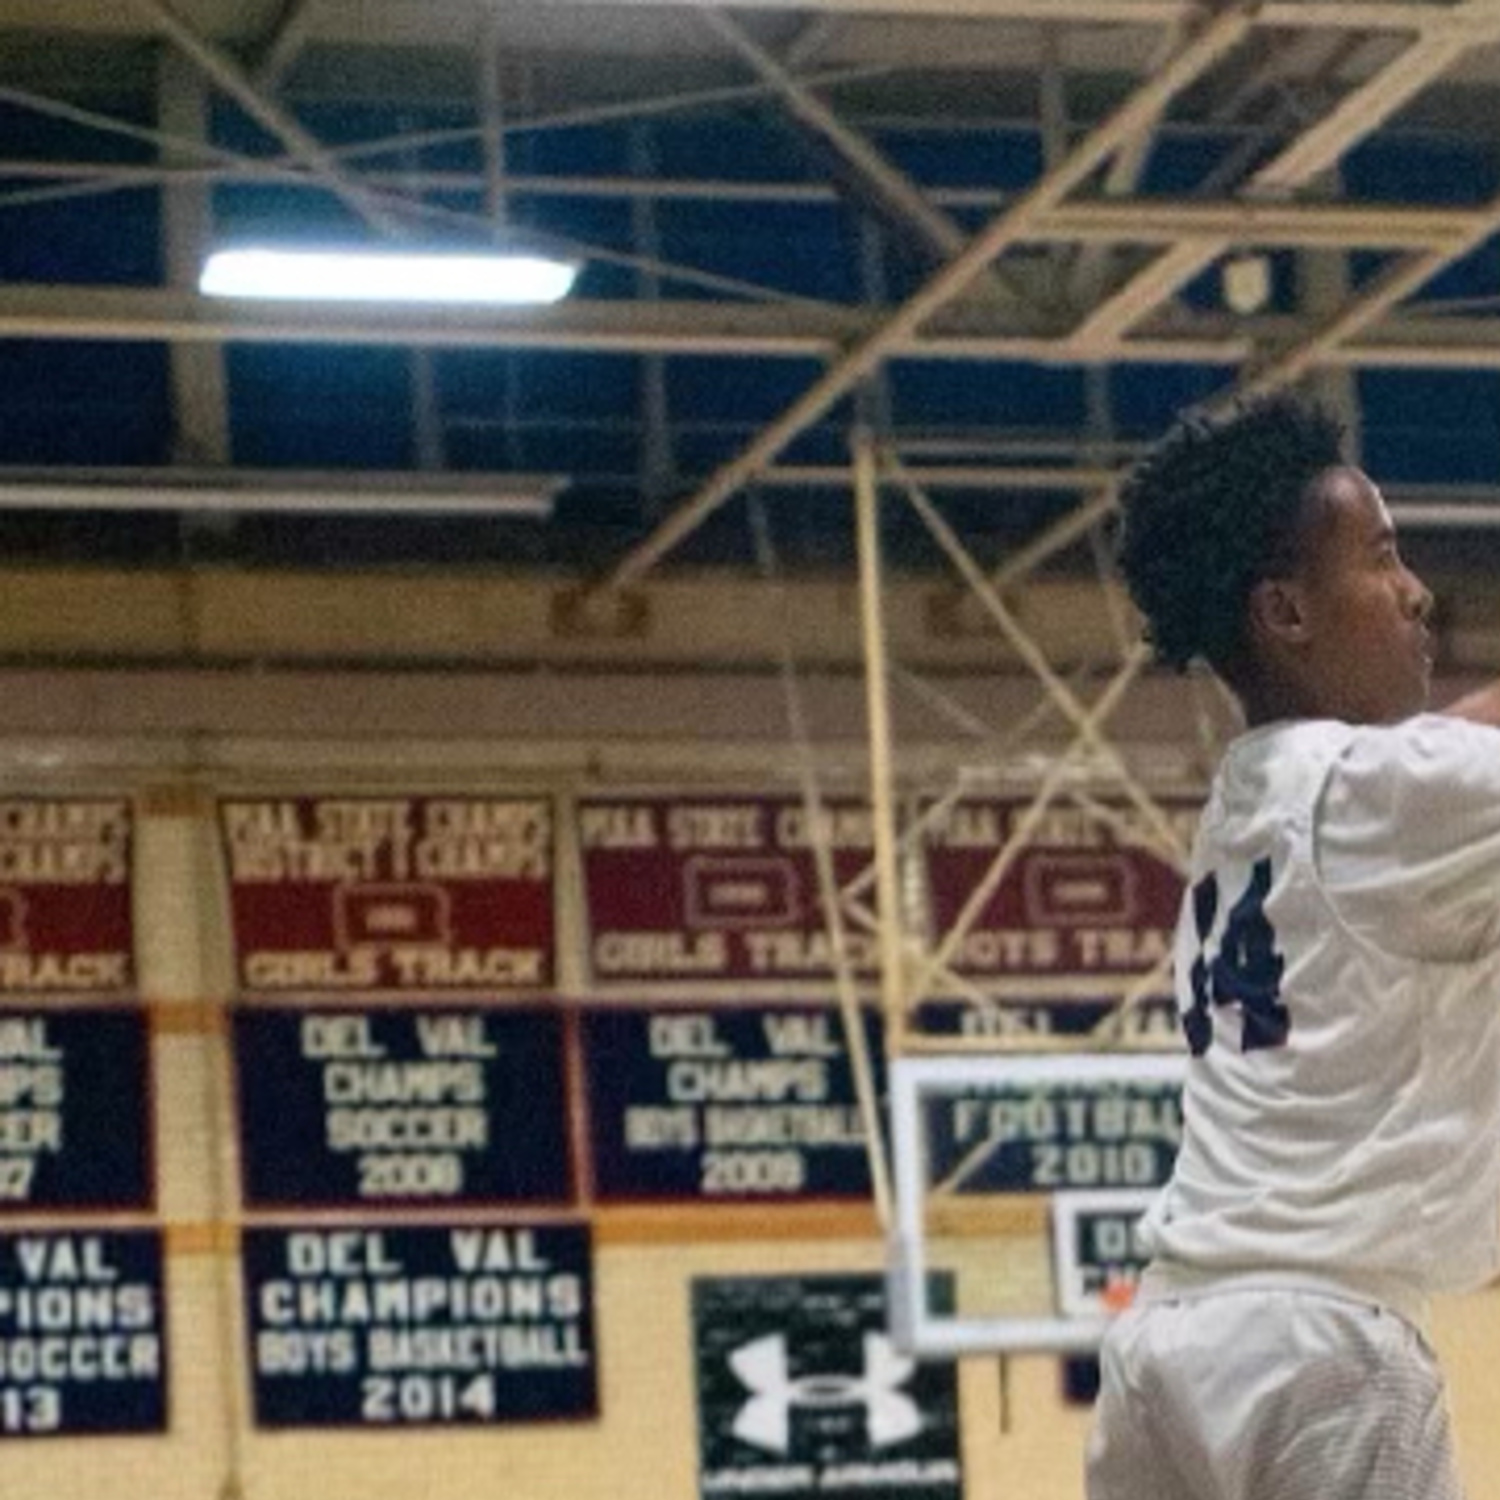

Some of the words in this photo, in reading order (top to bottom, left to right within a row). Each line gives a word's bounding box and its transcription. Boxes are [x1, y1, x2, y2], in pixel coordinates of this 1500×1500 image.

[392, 949, 543, 985] TRACK
[416, 1013, 498, 1057] VAL
[762, 1012, 841, 1055] VAL
[324, 1061, 485, 1103] CHAMPS
[667, 1058, 830, 1101] CHAMPS
[325, 1108, 489, 1151] SOCCER
[1031, 1144, 1157, 1186] 2010
[17, 1236, 118, 1282] VAL
[288, 1233, 402, 1275] DEL
[450, 1230, 549, 1272] VAL
[261, 1276, 581, 1324] CHAMPIONS
[0, 1333, 158, 1380] OCCER
[257, 1330, 354, 1374] BOYS
[368, 1325, 588, 1370] BASKETBALL
[361, 1376, 497, 1420] 2014
